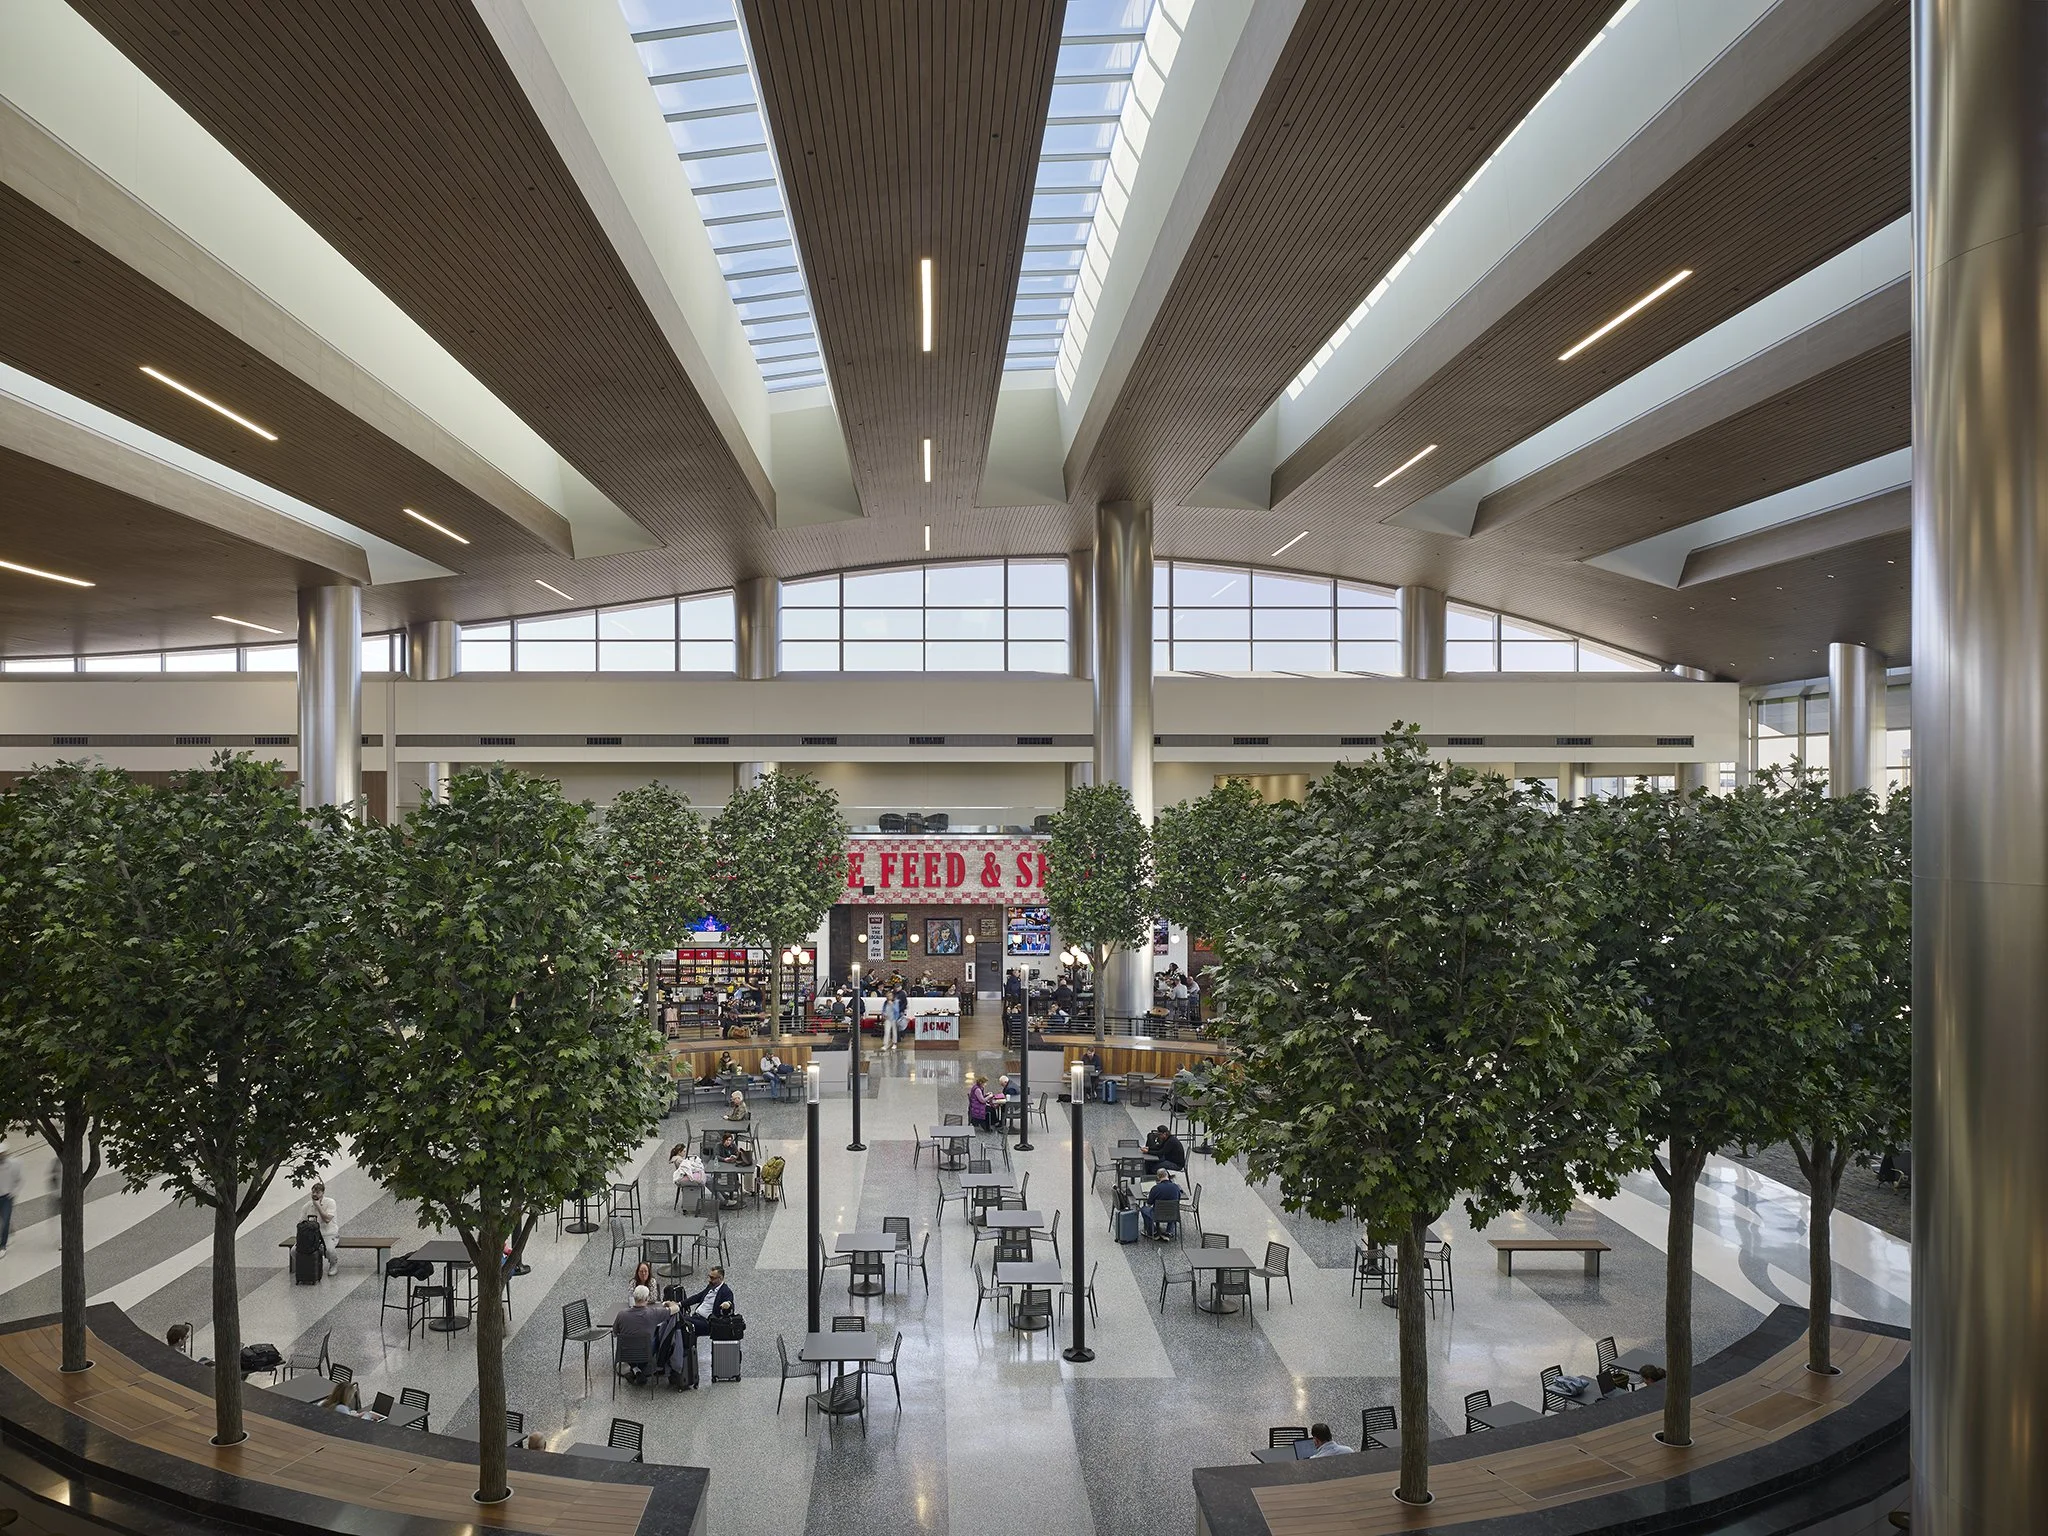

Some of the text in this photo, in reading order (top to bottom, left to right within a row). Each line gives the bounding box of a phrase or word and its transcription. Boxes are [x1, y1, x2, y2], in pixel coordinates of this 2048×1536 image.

[880, 852, 966, 888] FEED
[981, 851, 1002, 888] &
[922, 1021, 951, 1034] ACME
